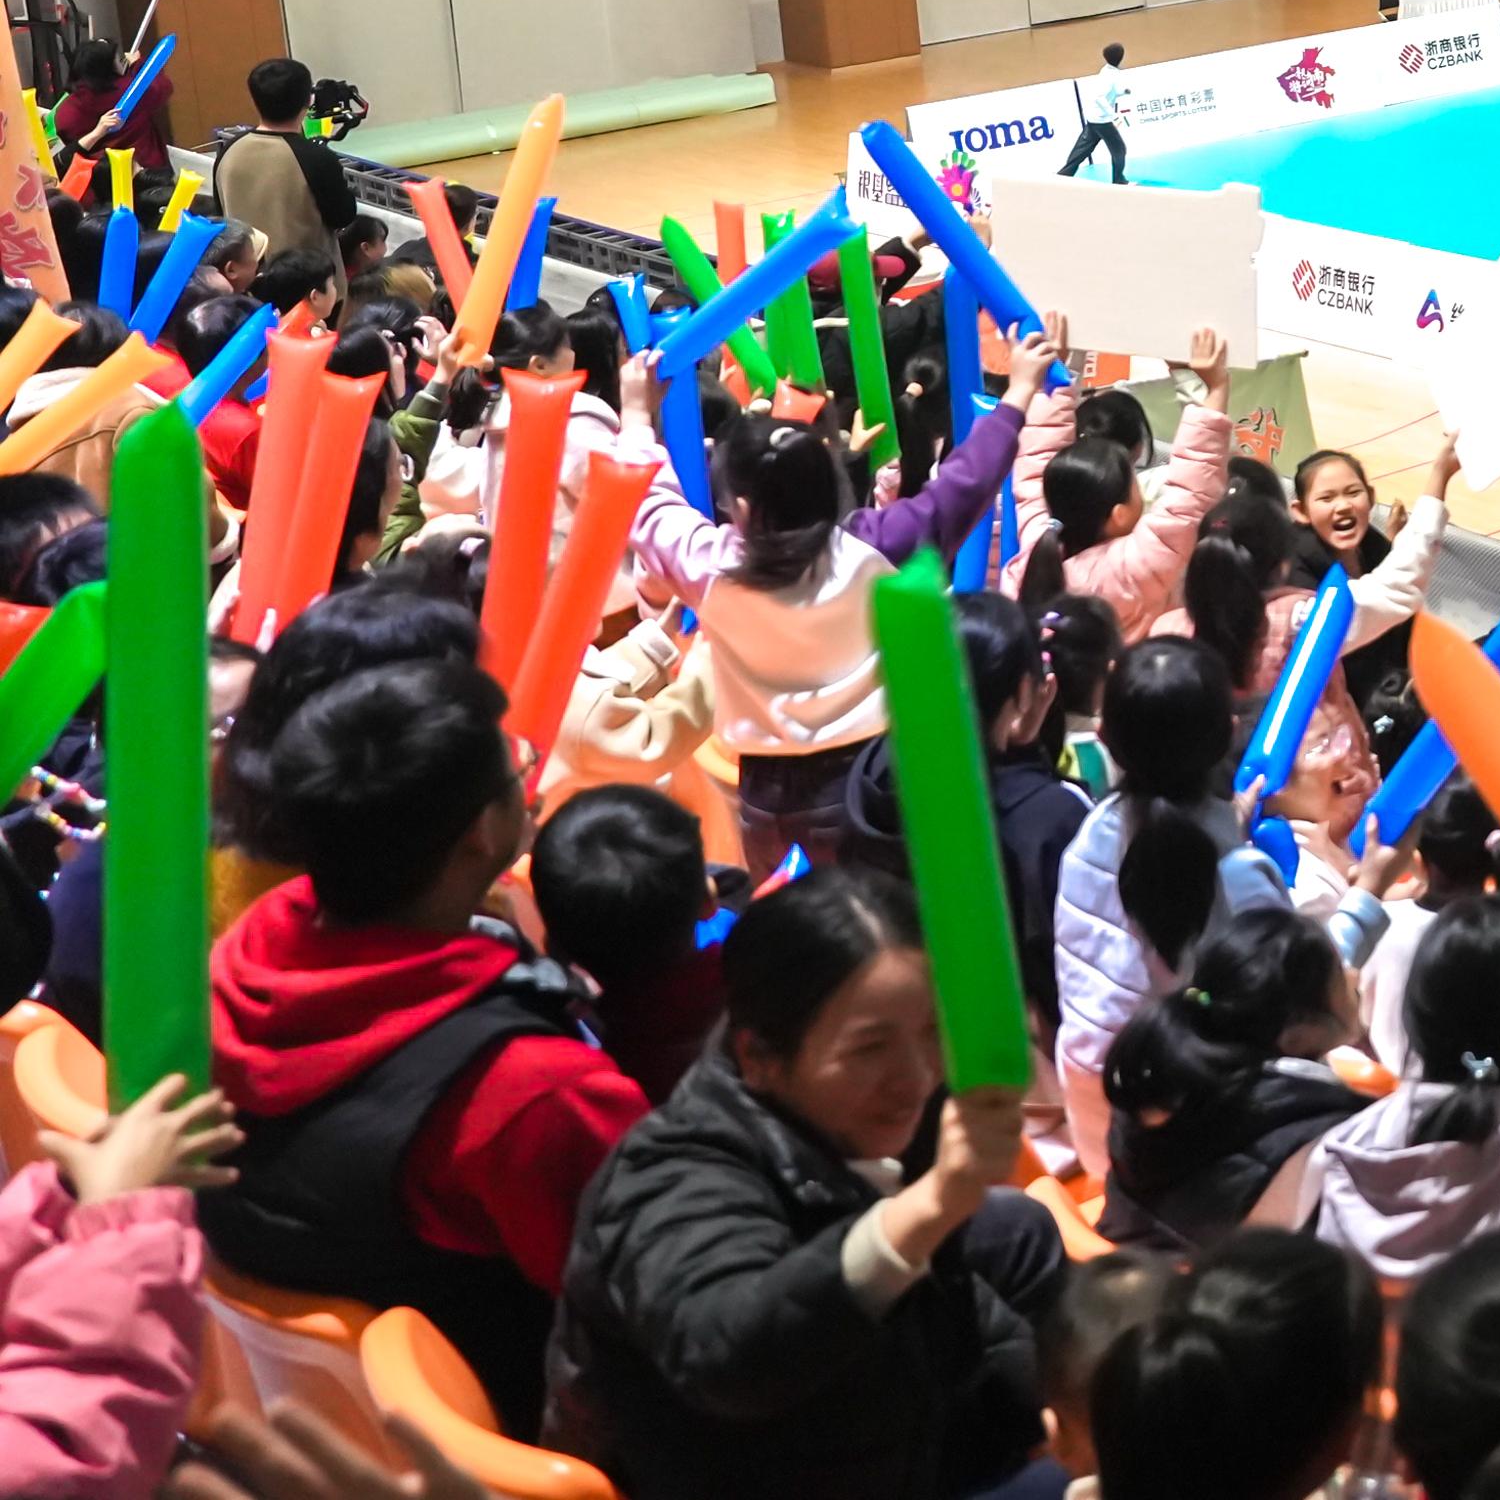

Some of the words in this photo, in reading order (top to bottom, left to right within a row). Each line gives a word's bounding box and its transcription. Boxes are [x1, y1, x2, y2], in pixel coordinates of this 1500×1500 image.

[1424, 33, 1481, 56] 浙商银行
[1427, 50, 1484, 70] CZBANK
[1137, 88, 1215, 114] 中国体育彩票
[1318, 265, 1375, 295] 浙商银行
[1317, 288, 1373, 316] CZBANK
